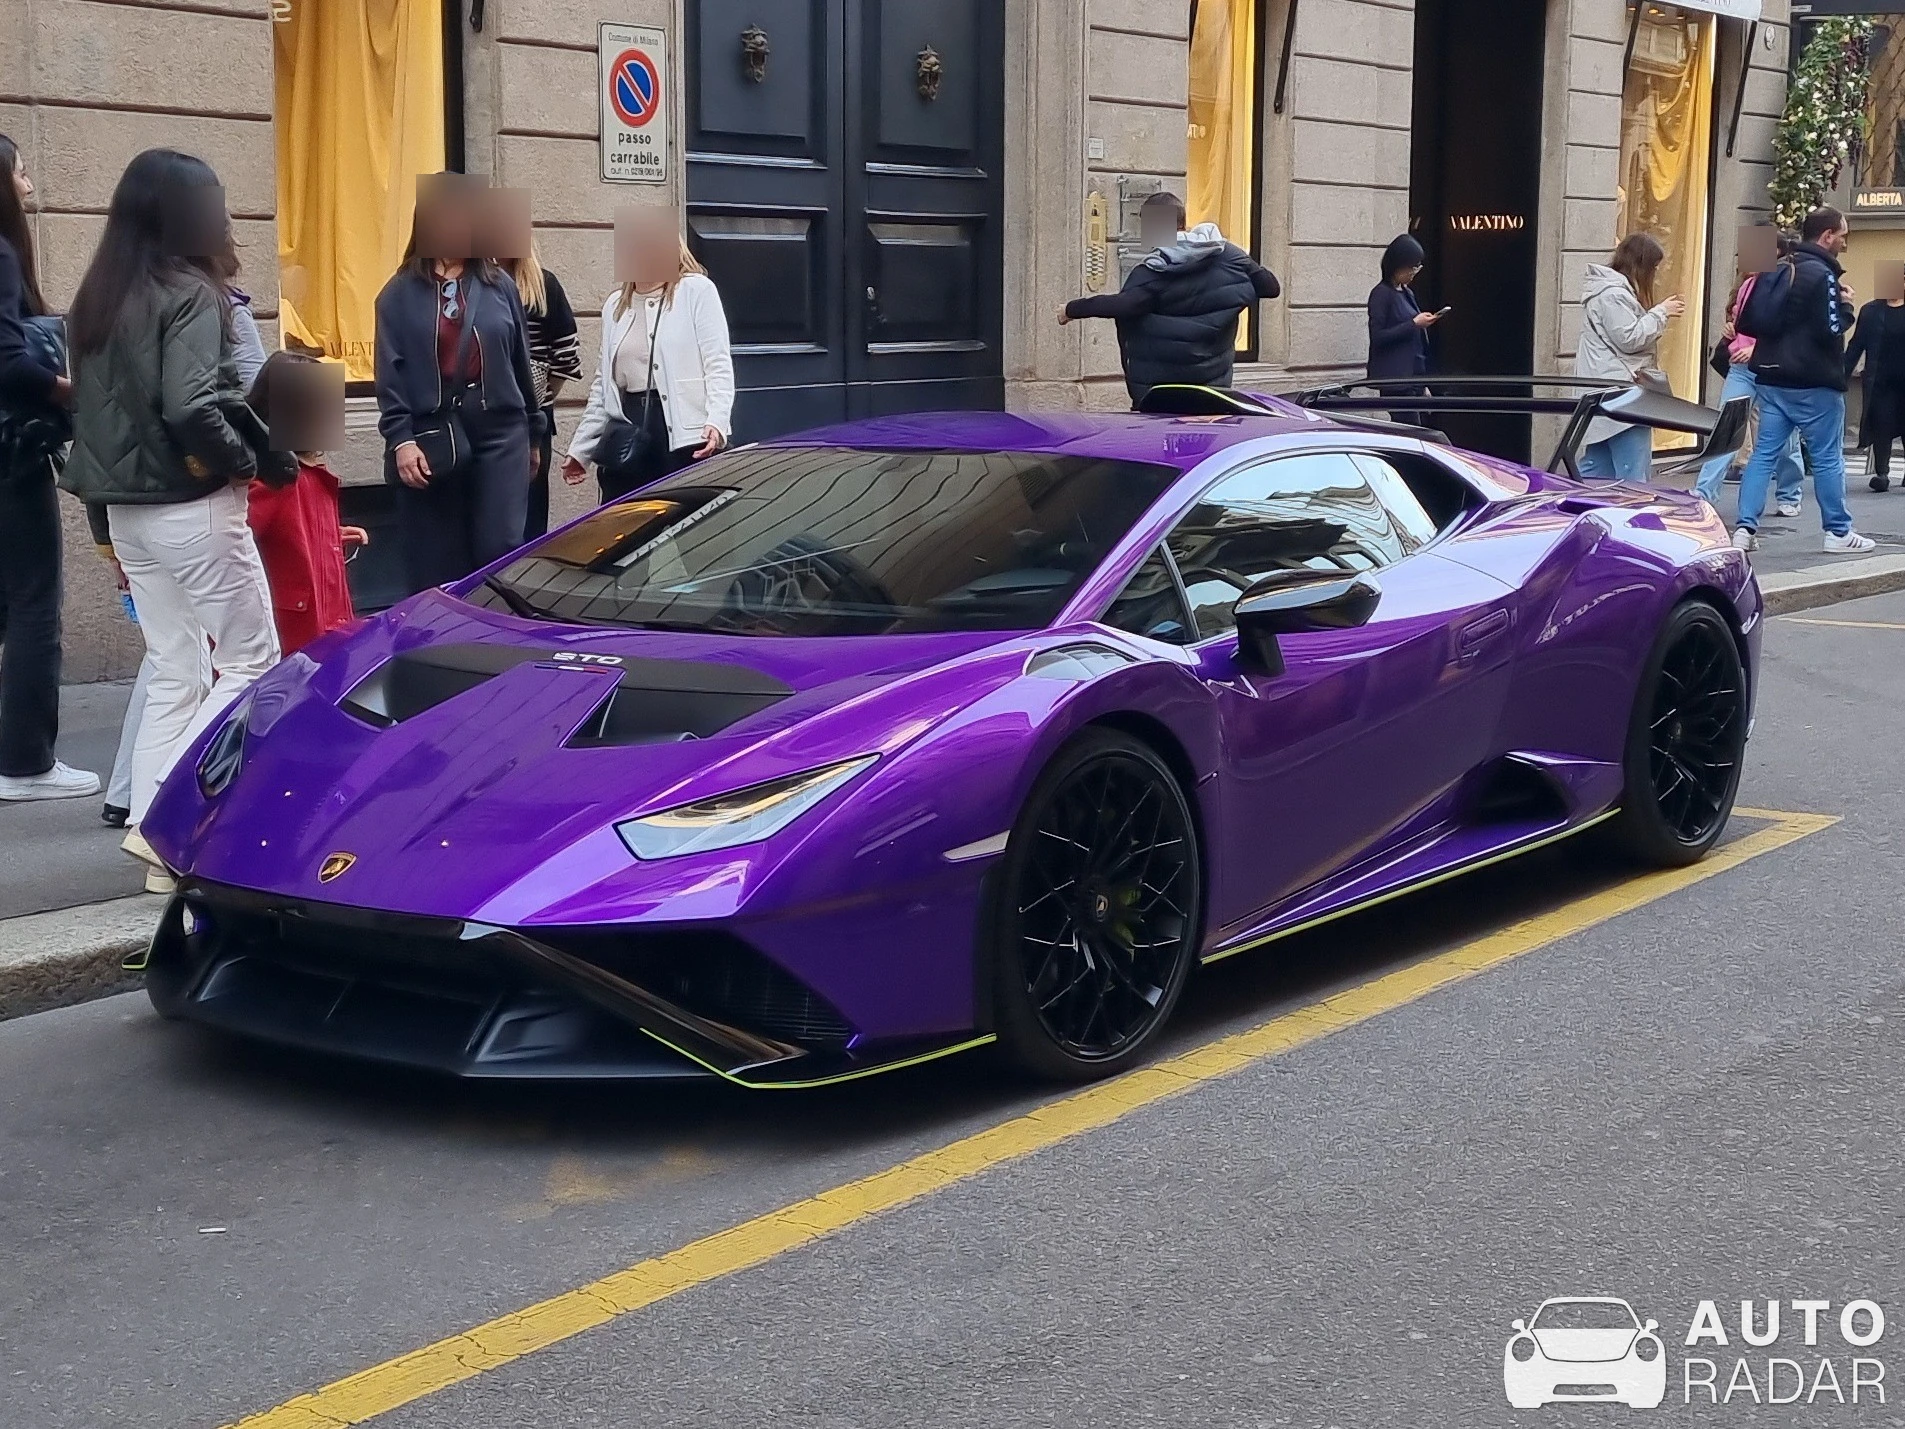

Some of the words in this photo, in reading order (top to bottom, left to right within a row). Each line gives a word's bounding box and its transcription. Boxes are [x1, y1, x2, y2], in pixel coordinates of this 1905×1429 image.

[618, 132, 652, 146] passo
[610, 151, 660, 165] carrabile
[1855, 192, 1903, 206] ALBERTA
[1450, 214, 1524, 230] VALENTINO
[552, 652, 624, 665] STO
